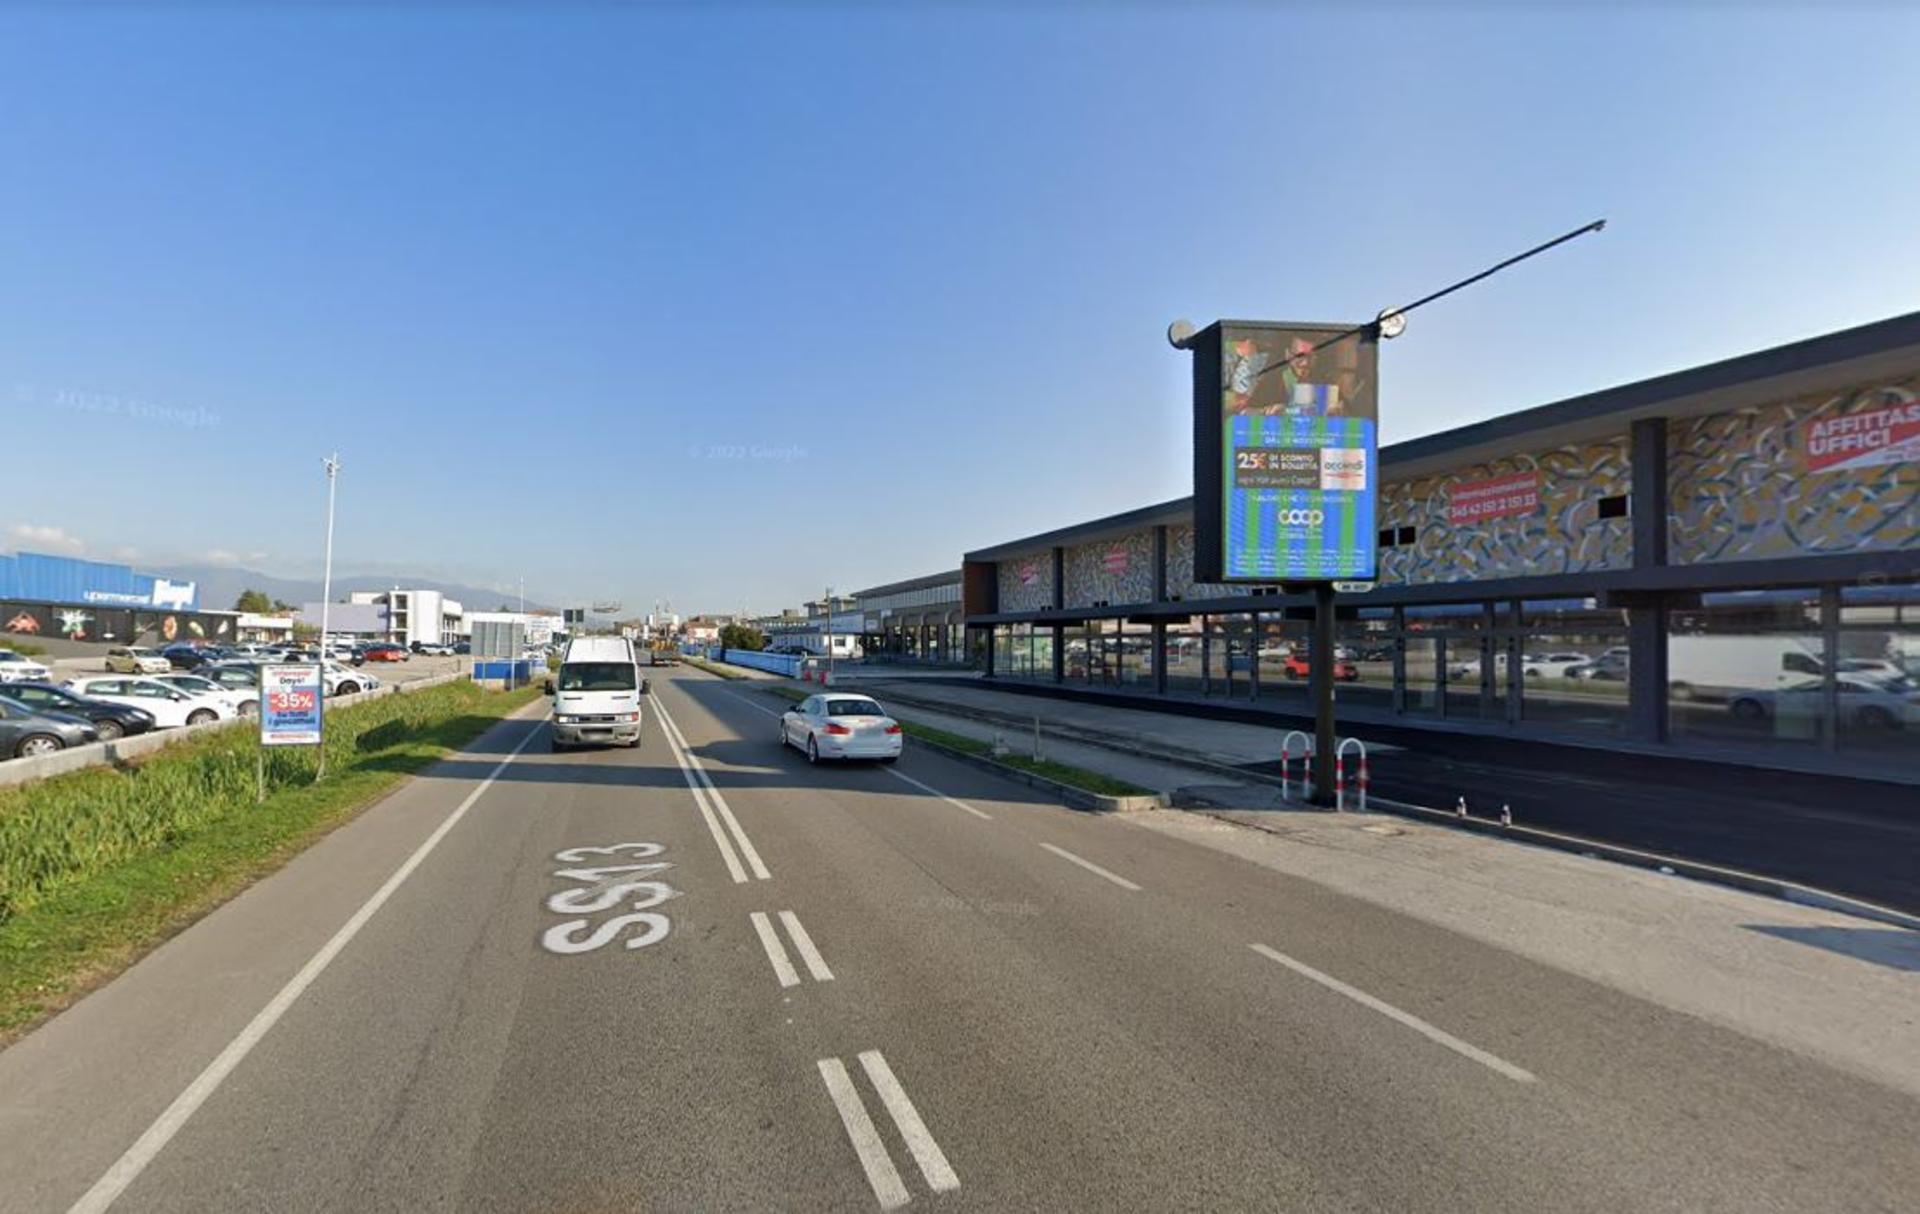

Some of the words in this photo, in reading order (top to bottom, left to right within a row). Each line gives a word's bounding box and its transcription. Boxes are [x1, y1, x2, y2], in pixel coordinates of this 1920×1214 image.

[1809, 428, 1891, 456] UFFICI
[1280, 454, 1315, 462] SCONTO
[1278, 509, 1324, 528] coop
[270, 693, 313, 707] -35%
[542, 842, 679, 954] SS13
